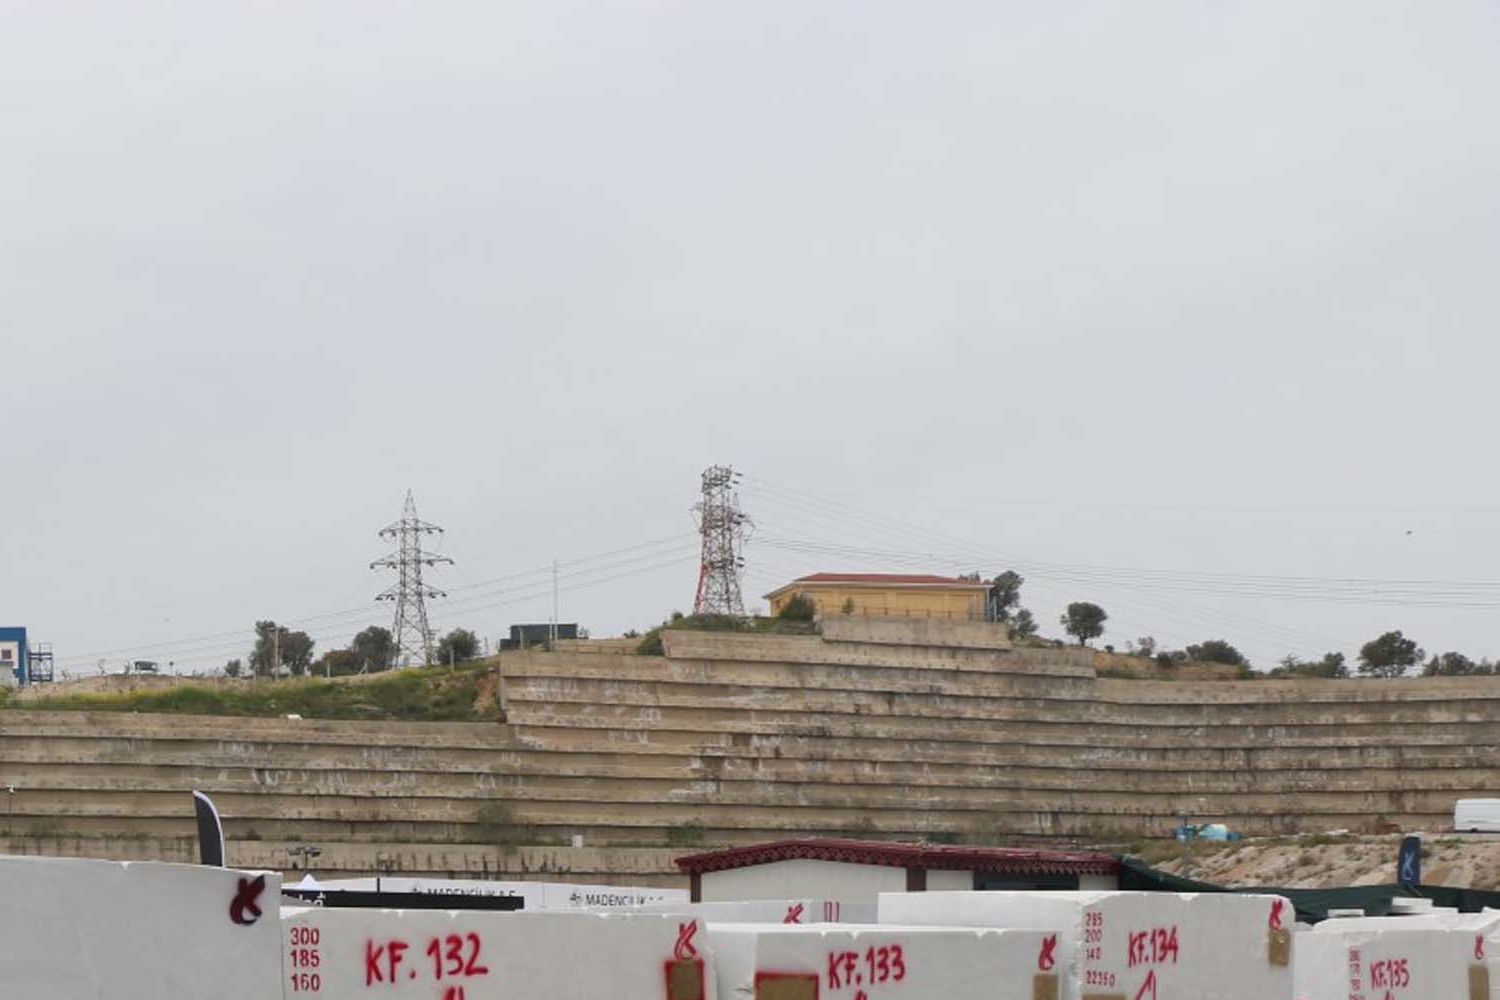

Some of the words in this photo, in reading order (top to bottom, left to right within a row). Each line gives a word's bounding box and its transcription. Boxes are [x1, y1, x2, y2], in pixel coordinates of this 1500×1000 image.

[290, 927, 320, 945] 300
[291, 949, 320, 967] 185
[291, 973, 321, 991] 160
